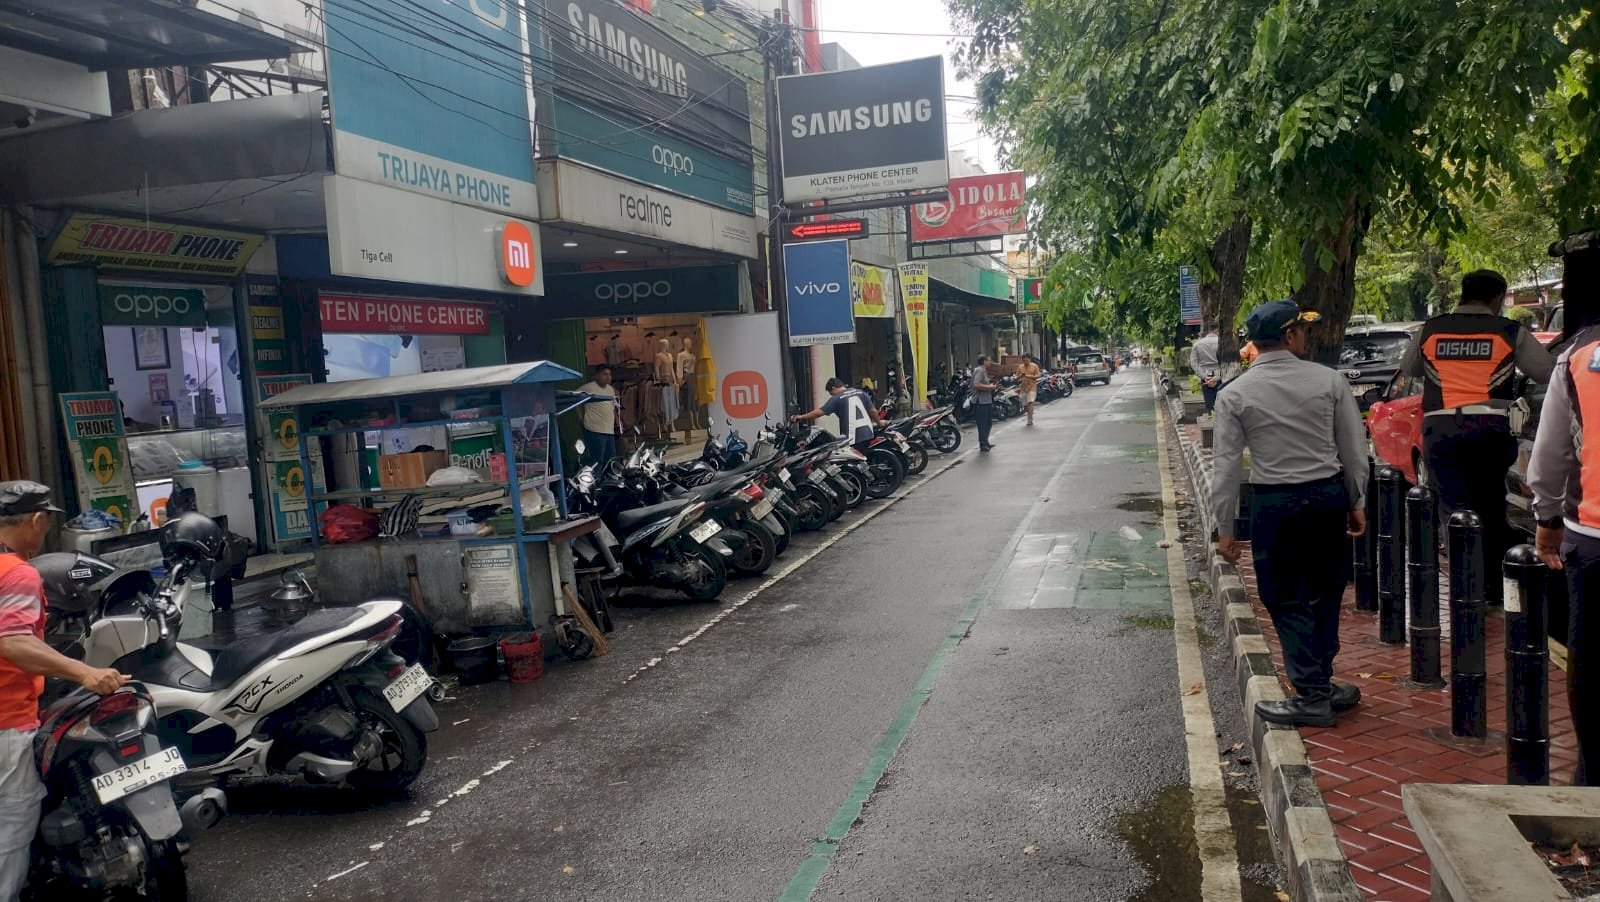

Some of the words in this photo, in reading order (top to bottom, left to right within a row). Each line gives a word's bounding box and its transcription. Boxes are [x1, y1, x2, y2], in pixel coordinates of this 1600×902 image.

[567, 3, 688, 101] SAMSUNG
[791, 99, 932, 138] SAMSUNG
[651, 144, 694, 176] oppo
[378, 151, 452, 194] TRIJAYA
[455, 170, 511, 208] PHONE
[810, 175, 845, 187] KLATEN
[848, 169, 879, 183] PHONE
[881, 166, 919, 178] CENTER
[958, 181, 1021, 206] IDOLA
[618, 191, 673, 228] realme
[81, 223, 176, 254] TRIJAYA
[171, 233, 244, 260] PHONE
[361, 249, 377, 265] Tiga
[379, 251, 393, 263] Cell
[594, 280, 672, 303] oppo
[794, 281, 841, 296] vivo
[114, 294, 190, 319] oppo
[365, 302, 424, 324] PHONE
[427, 306, 485, 326] CENTER
[831, 334, 850, 342] CENTER
[1437, 341, 1491, 356] DISHUB
[68, 399, 116, 416] TRIJAYA
[848, 395, 874, 445] A
[76, 419, 117, 437] PHONE
[242, 674, 274, 705] PCX
[95, 777, 114, 791] AD
[115, 759, 151, 782] 3314
